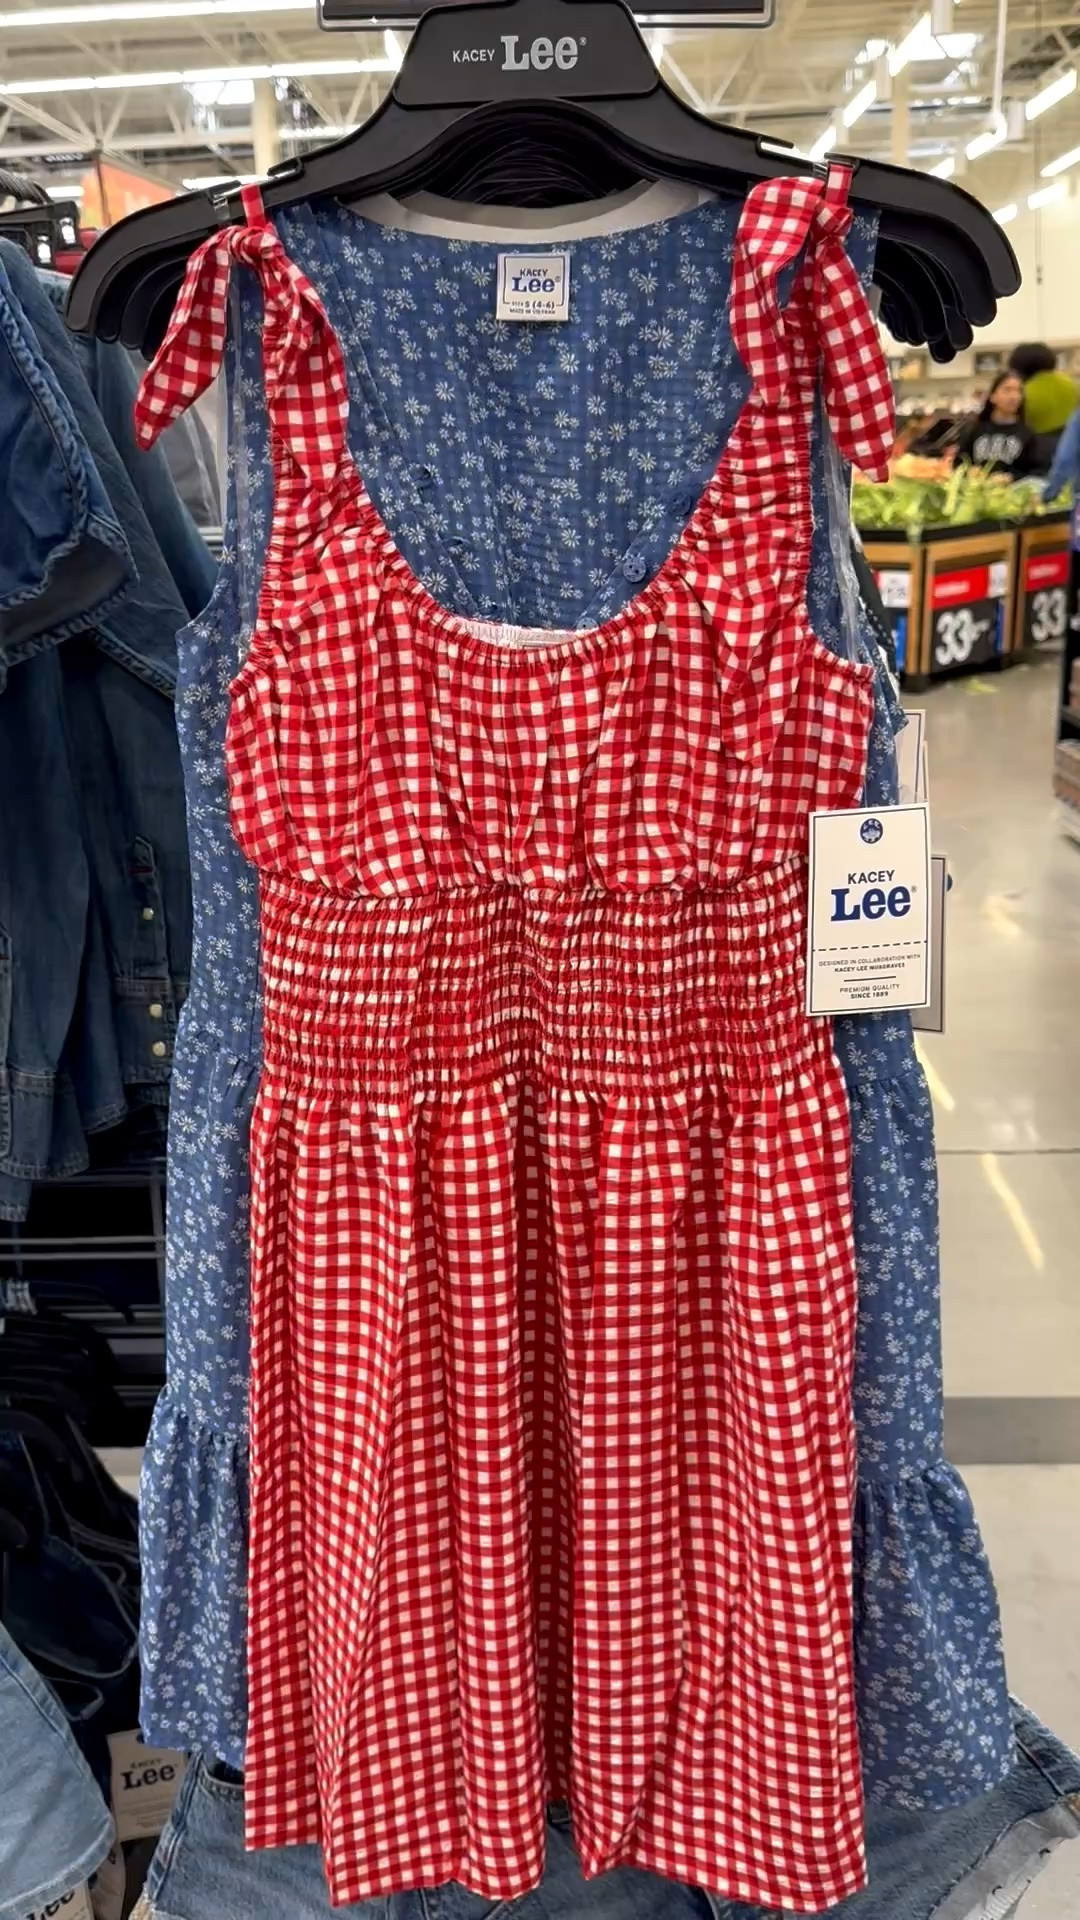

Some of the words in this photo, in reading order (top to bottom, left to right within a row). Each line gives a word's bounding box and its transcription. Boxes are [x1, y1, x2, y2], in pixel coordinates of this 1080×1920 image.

[452, 49, 495, 63] KACEY
[519, 268, 548, 277] KACEY
[847, 870, 895, 885] KACEY
[818, 959, 849, 967] DESIGNED
[857, 955, 905, 965] COLLABORATION
[839, 985, 870, 993] PREMIUM
[872, 983, 900, 992] QUALITY
[850, 992, 871, 1000] SINCE
